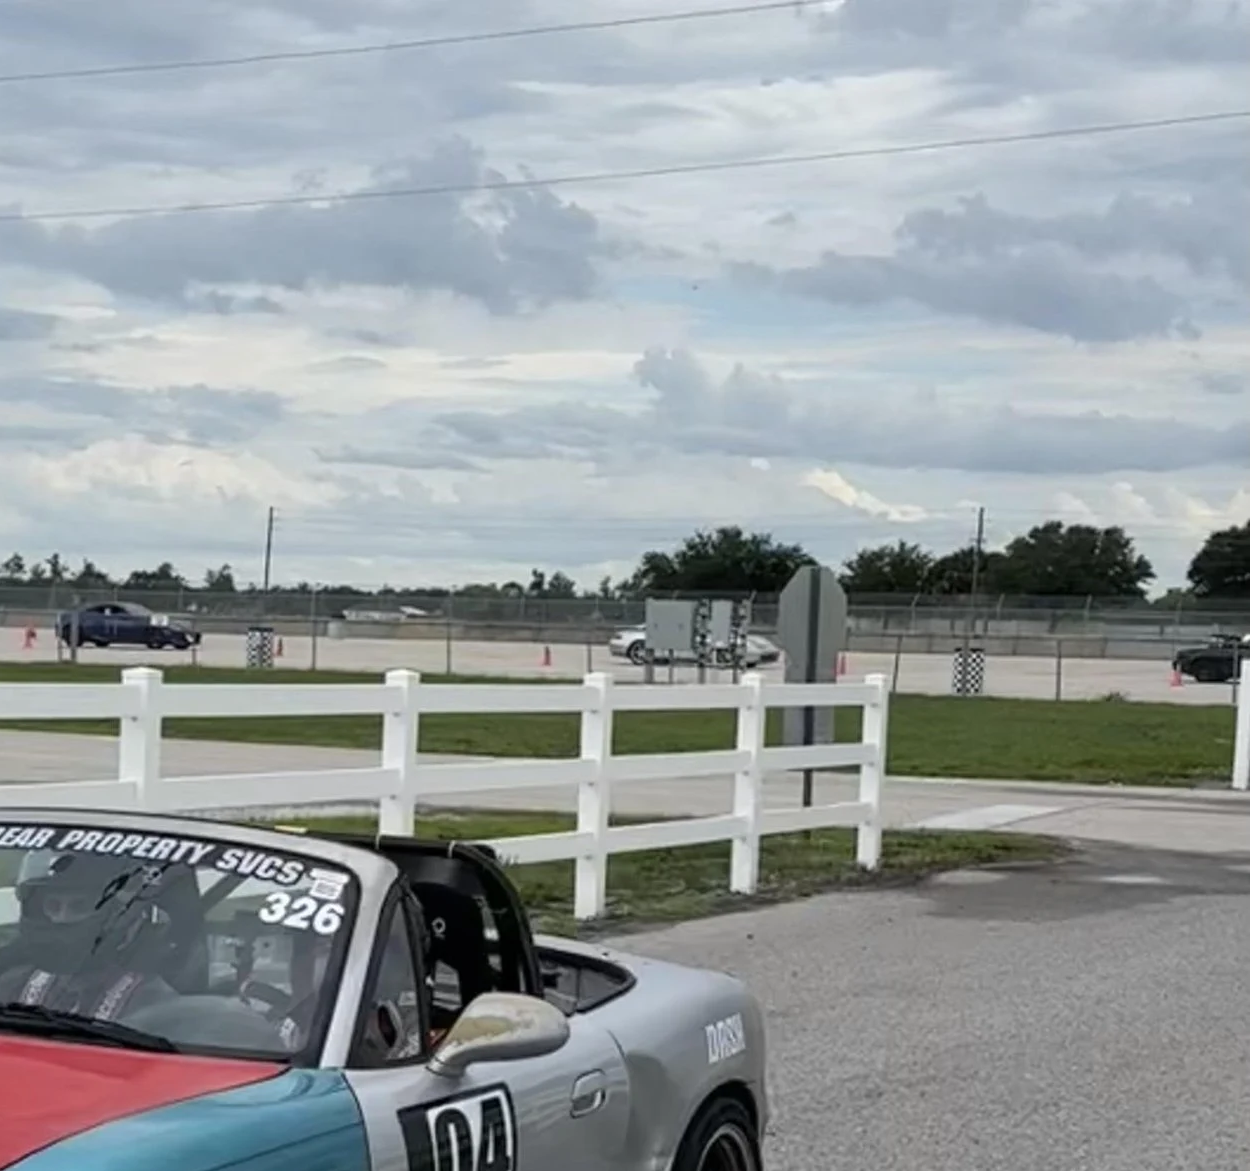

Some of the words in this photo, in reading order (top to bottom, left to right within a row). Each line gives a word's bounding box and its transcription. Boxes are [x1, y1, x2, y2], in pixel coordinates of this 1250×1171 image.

[56, 829, 217, 865] PROPERTY
[215, 848, 305, 884] SVCS
[258, 891, 346, 935] 326
